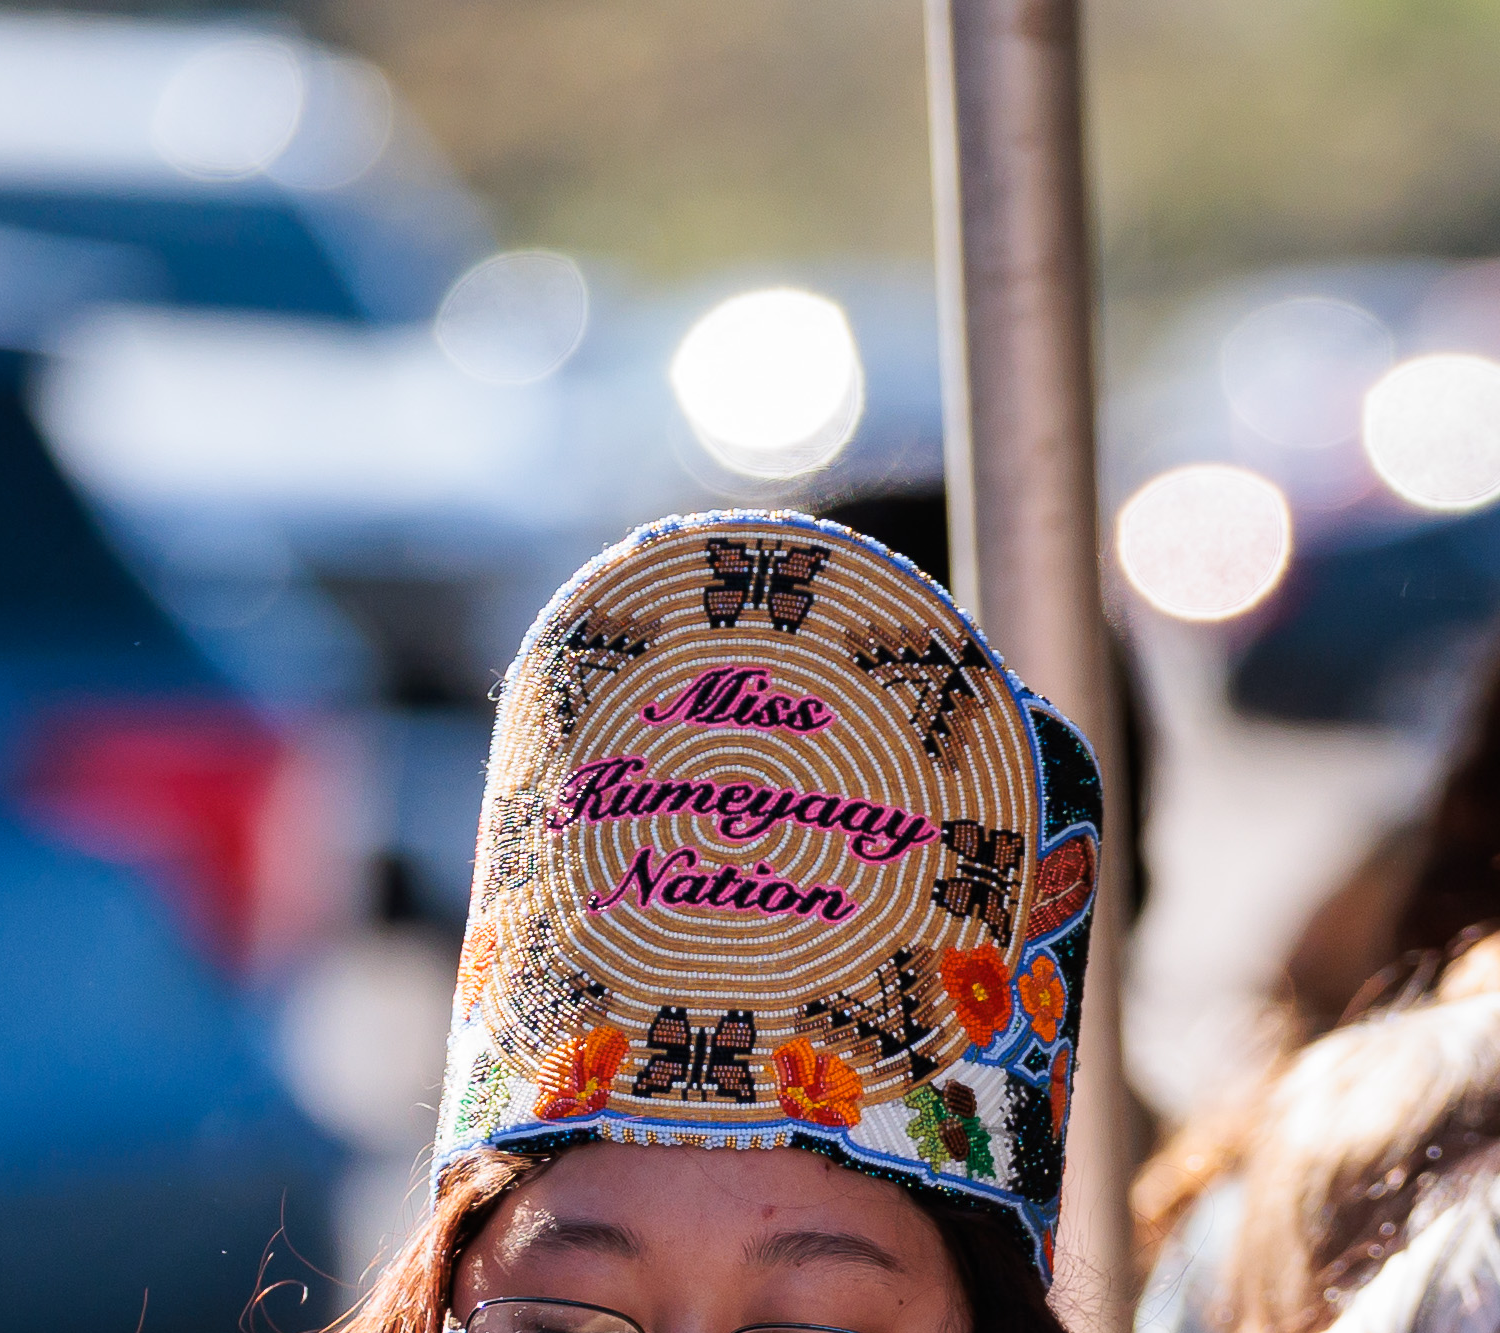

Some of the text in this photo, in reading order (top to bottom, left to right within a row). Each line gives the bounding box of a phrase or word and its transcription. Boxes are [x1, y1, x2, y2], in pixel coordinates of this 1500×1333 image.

[641, 666, 835, 732] Miss
[547, 757, 944, 864] Kumeyaay
[588, 846, 858, 924] Nation
